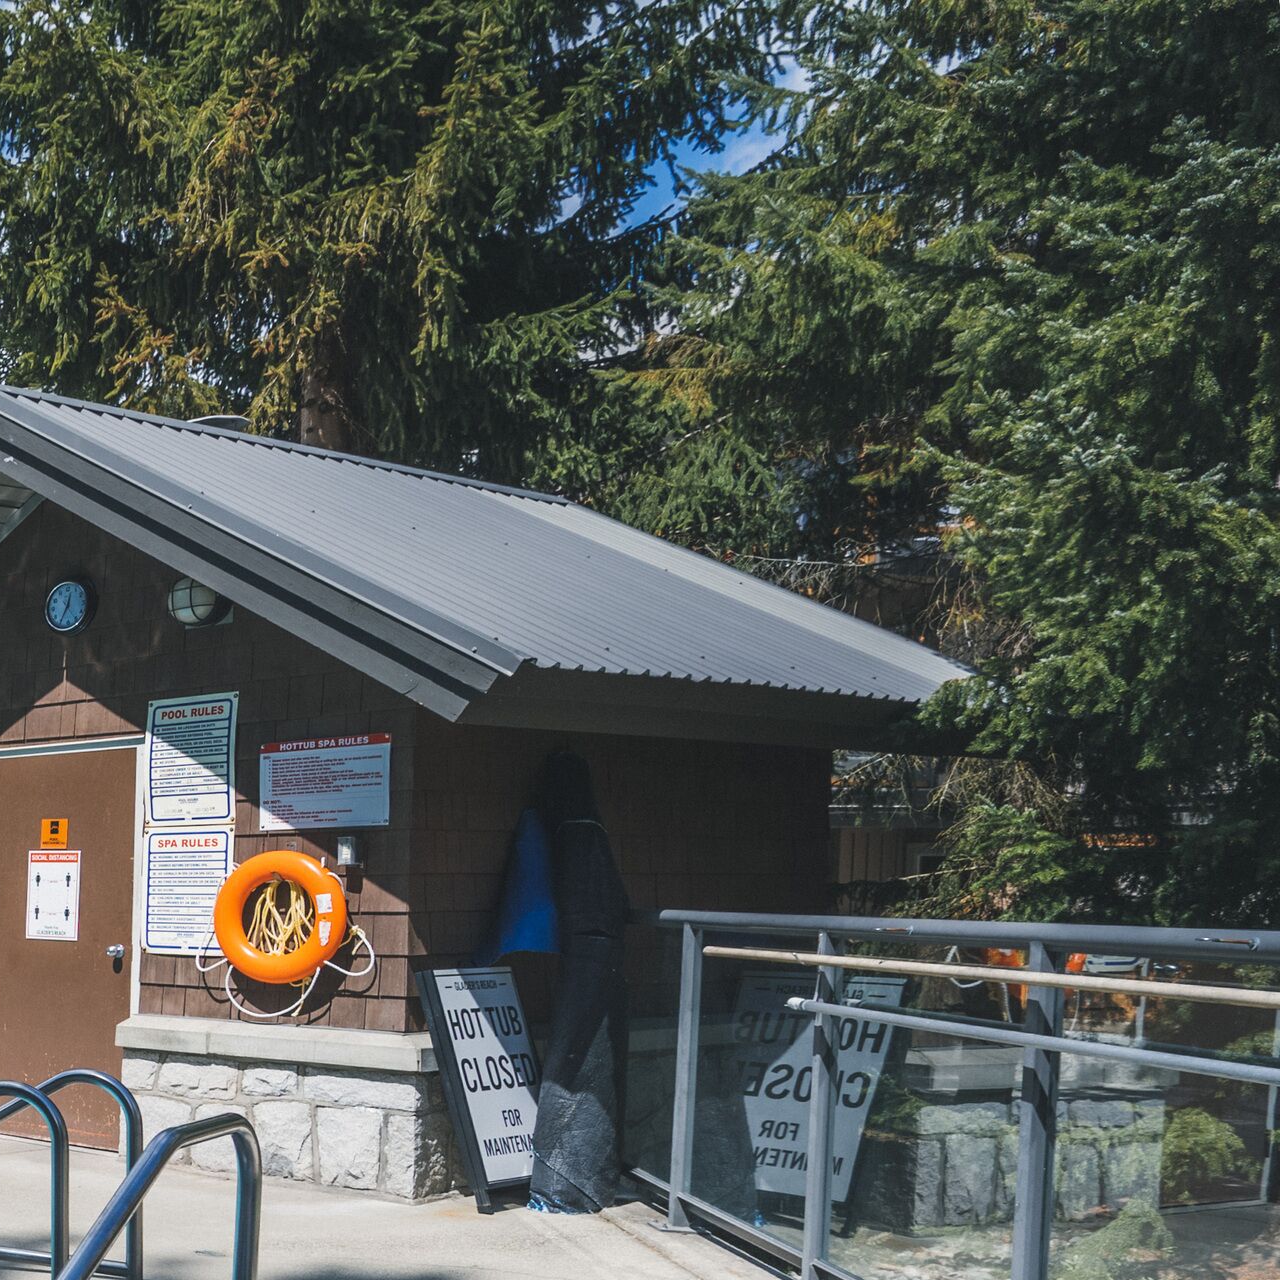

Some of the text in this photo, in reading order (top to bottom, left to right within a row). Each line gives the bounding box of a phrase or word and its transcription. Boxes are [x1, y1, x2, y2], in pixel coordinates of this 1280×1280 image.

[161, 705, 224, 720] POOL RULES
[280, 736, 369, 751] HOTTUB SPA RULES
[158, 838, 218, 848] SPA RULES
[447, 1005, 522, 1040] HOT TUB
[461, 1053, 537, 1093] CLOSED
[501, 1108, 523, 1128] FOR
